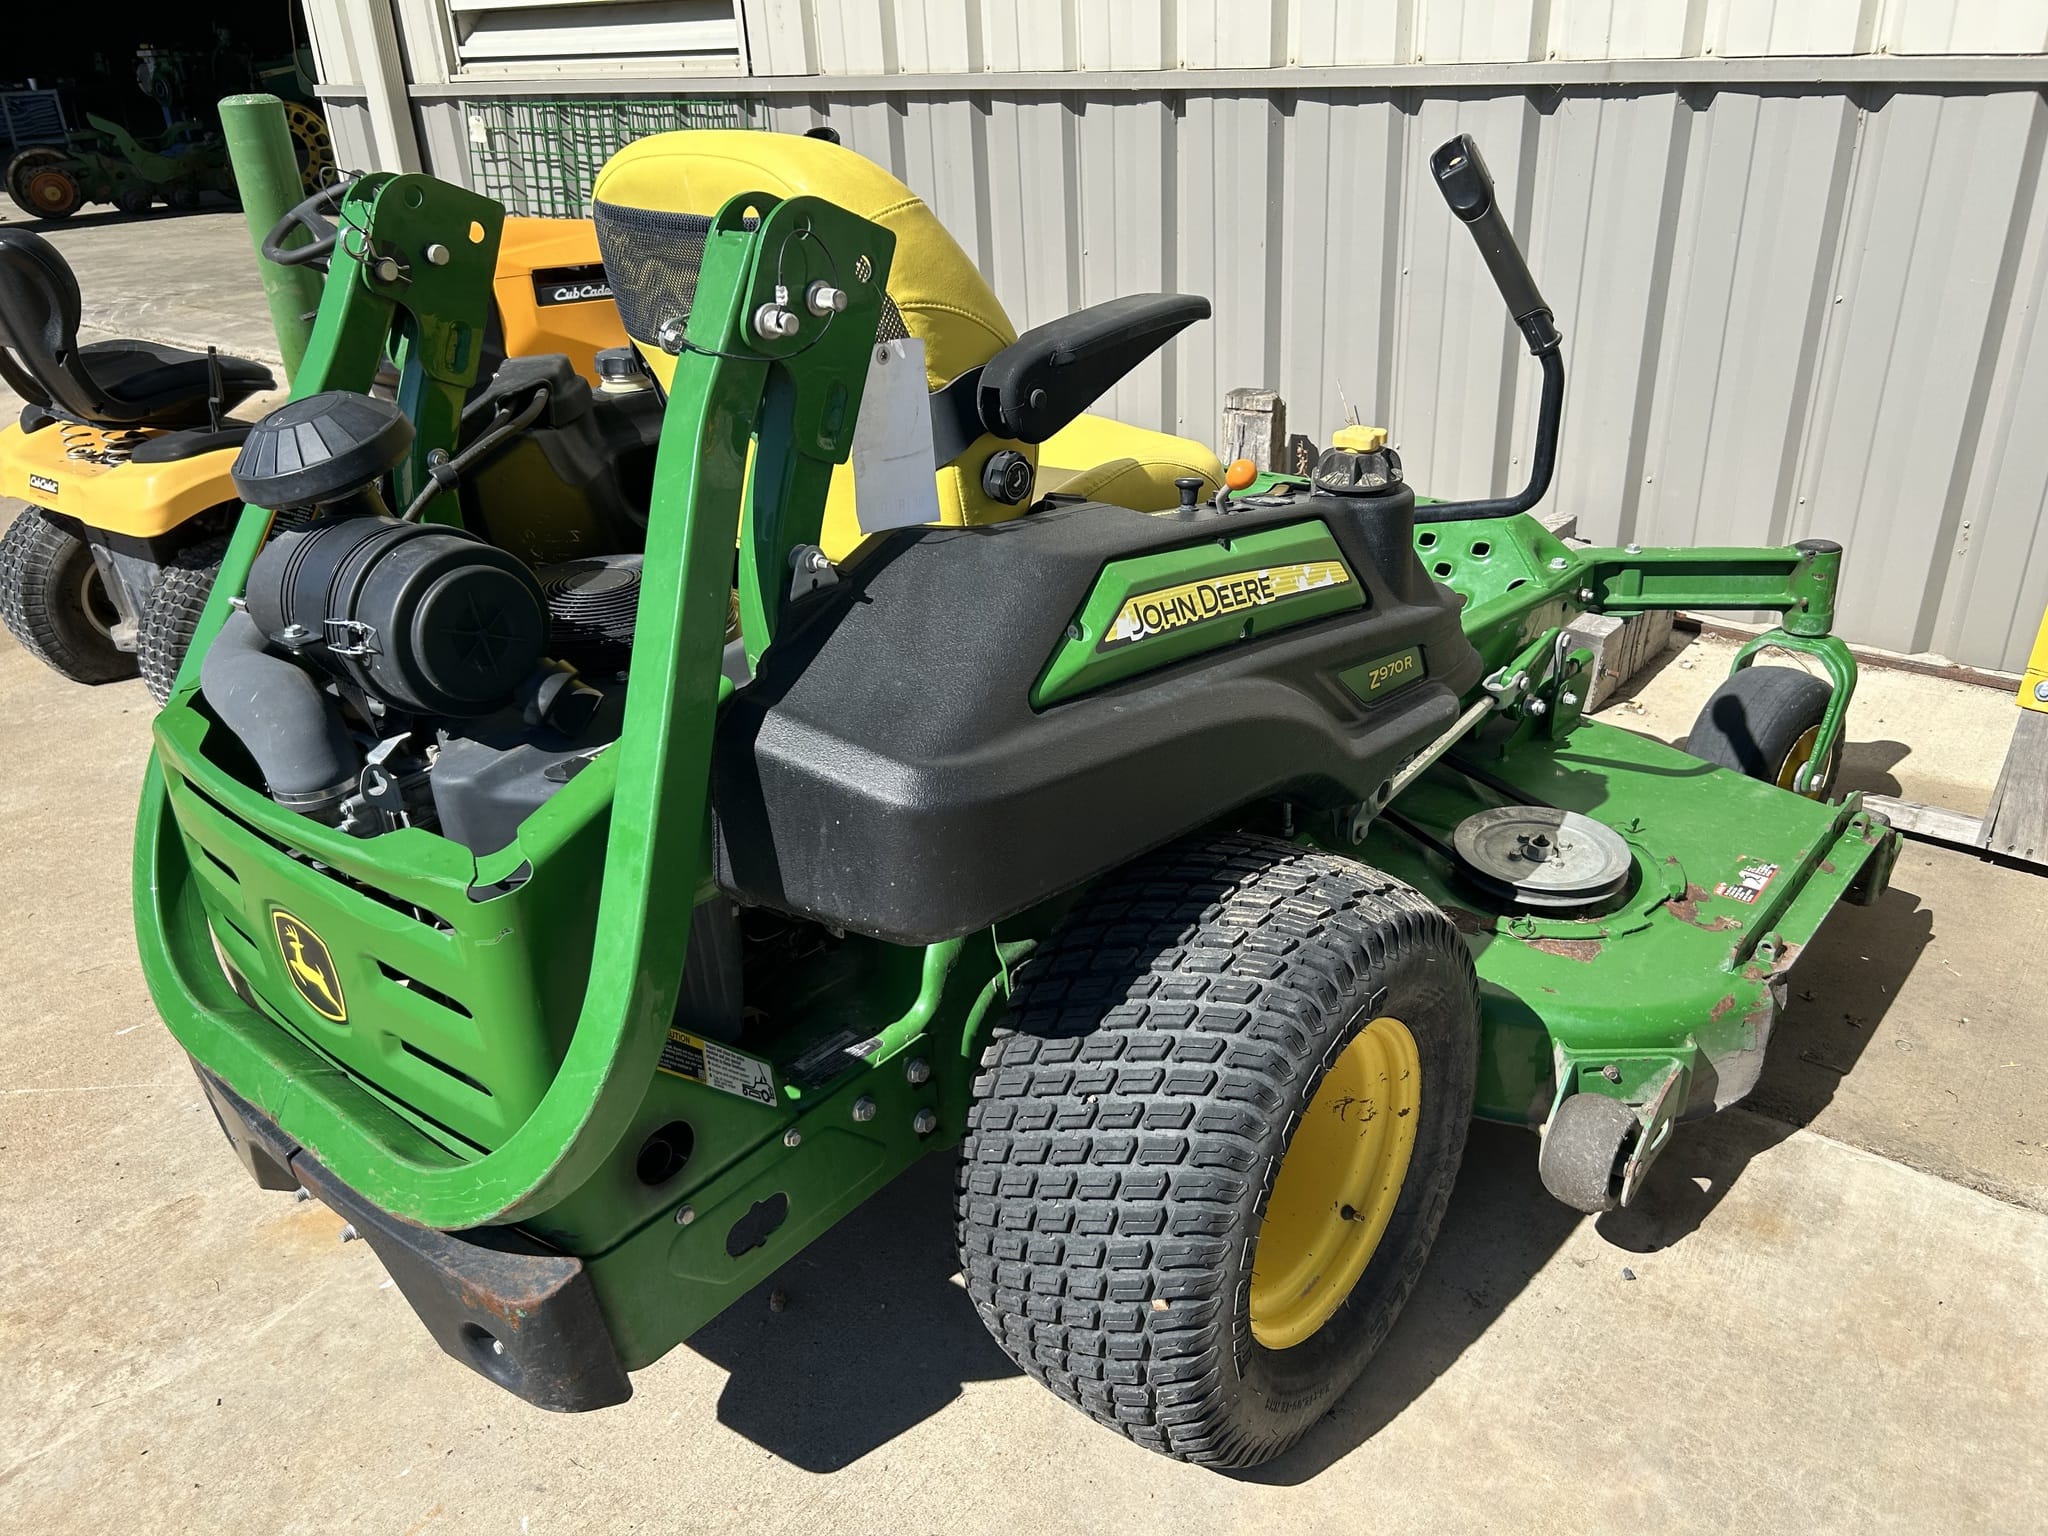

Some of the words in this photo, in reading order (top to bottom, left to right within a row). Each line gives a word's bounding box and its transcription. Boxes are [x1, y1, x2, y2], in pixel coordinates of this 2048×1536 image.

[555, 287, 580, 301] Cub
[581, 285, 613, 298] Cade
[1131, 592, 1198, 635] JOHN
[1196, 576, 1275, 614] DEERE
[1368, 655, 1413, 690] Z970R
[667, 1031, 691, 1044] UTION
